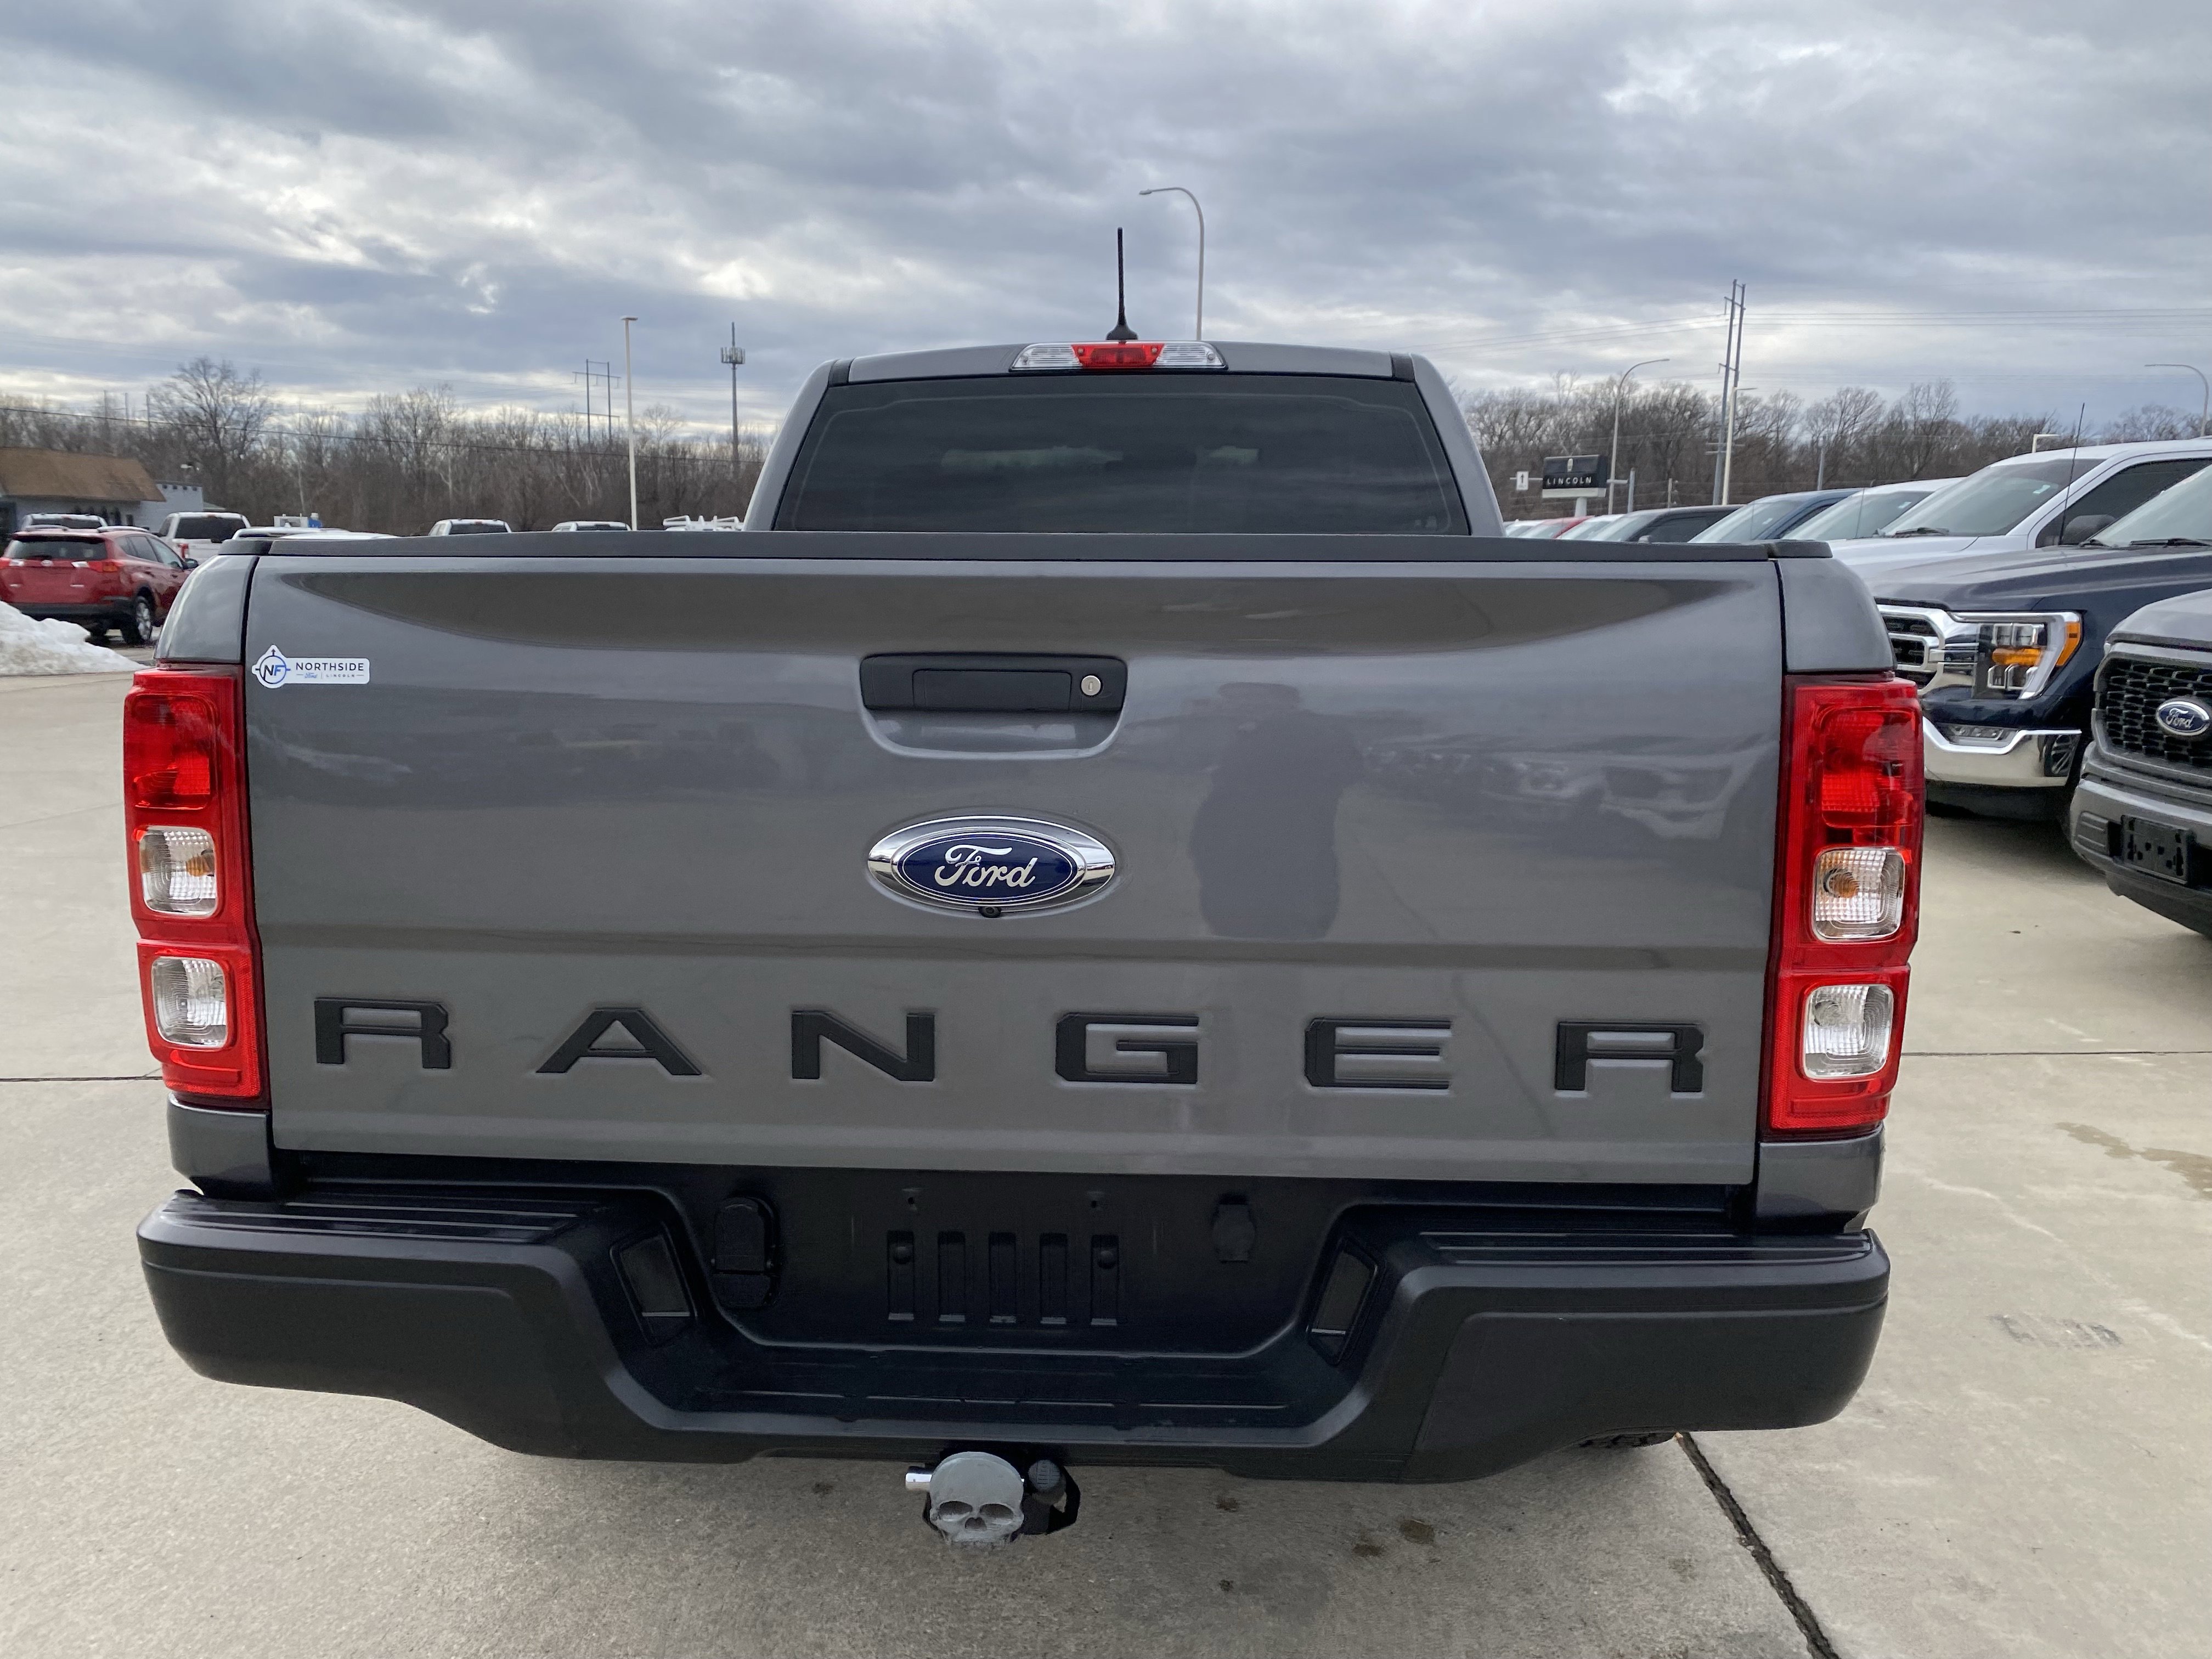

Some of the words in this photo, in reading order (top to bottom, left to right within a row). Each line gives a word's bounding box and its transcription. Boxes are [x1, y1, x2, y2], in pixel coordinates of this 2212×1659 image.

[1546, 476, 1592, 485] LINCOLN
[296, 662, 364, 671] NORTHSIDE
[2165, 707, 2195, 729] Ford
[934, 844, 1039, 888] Ford
[314, 997, 1704, 1093] RANGER
